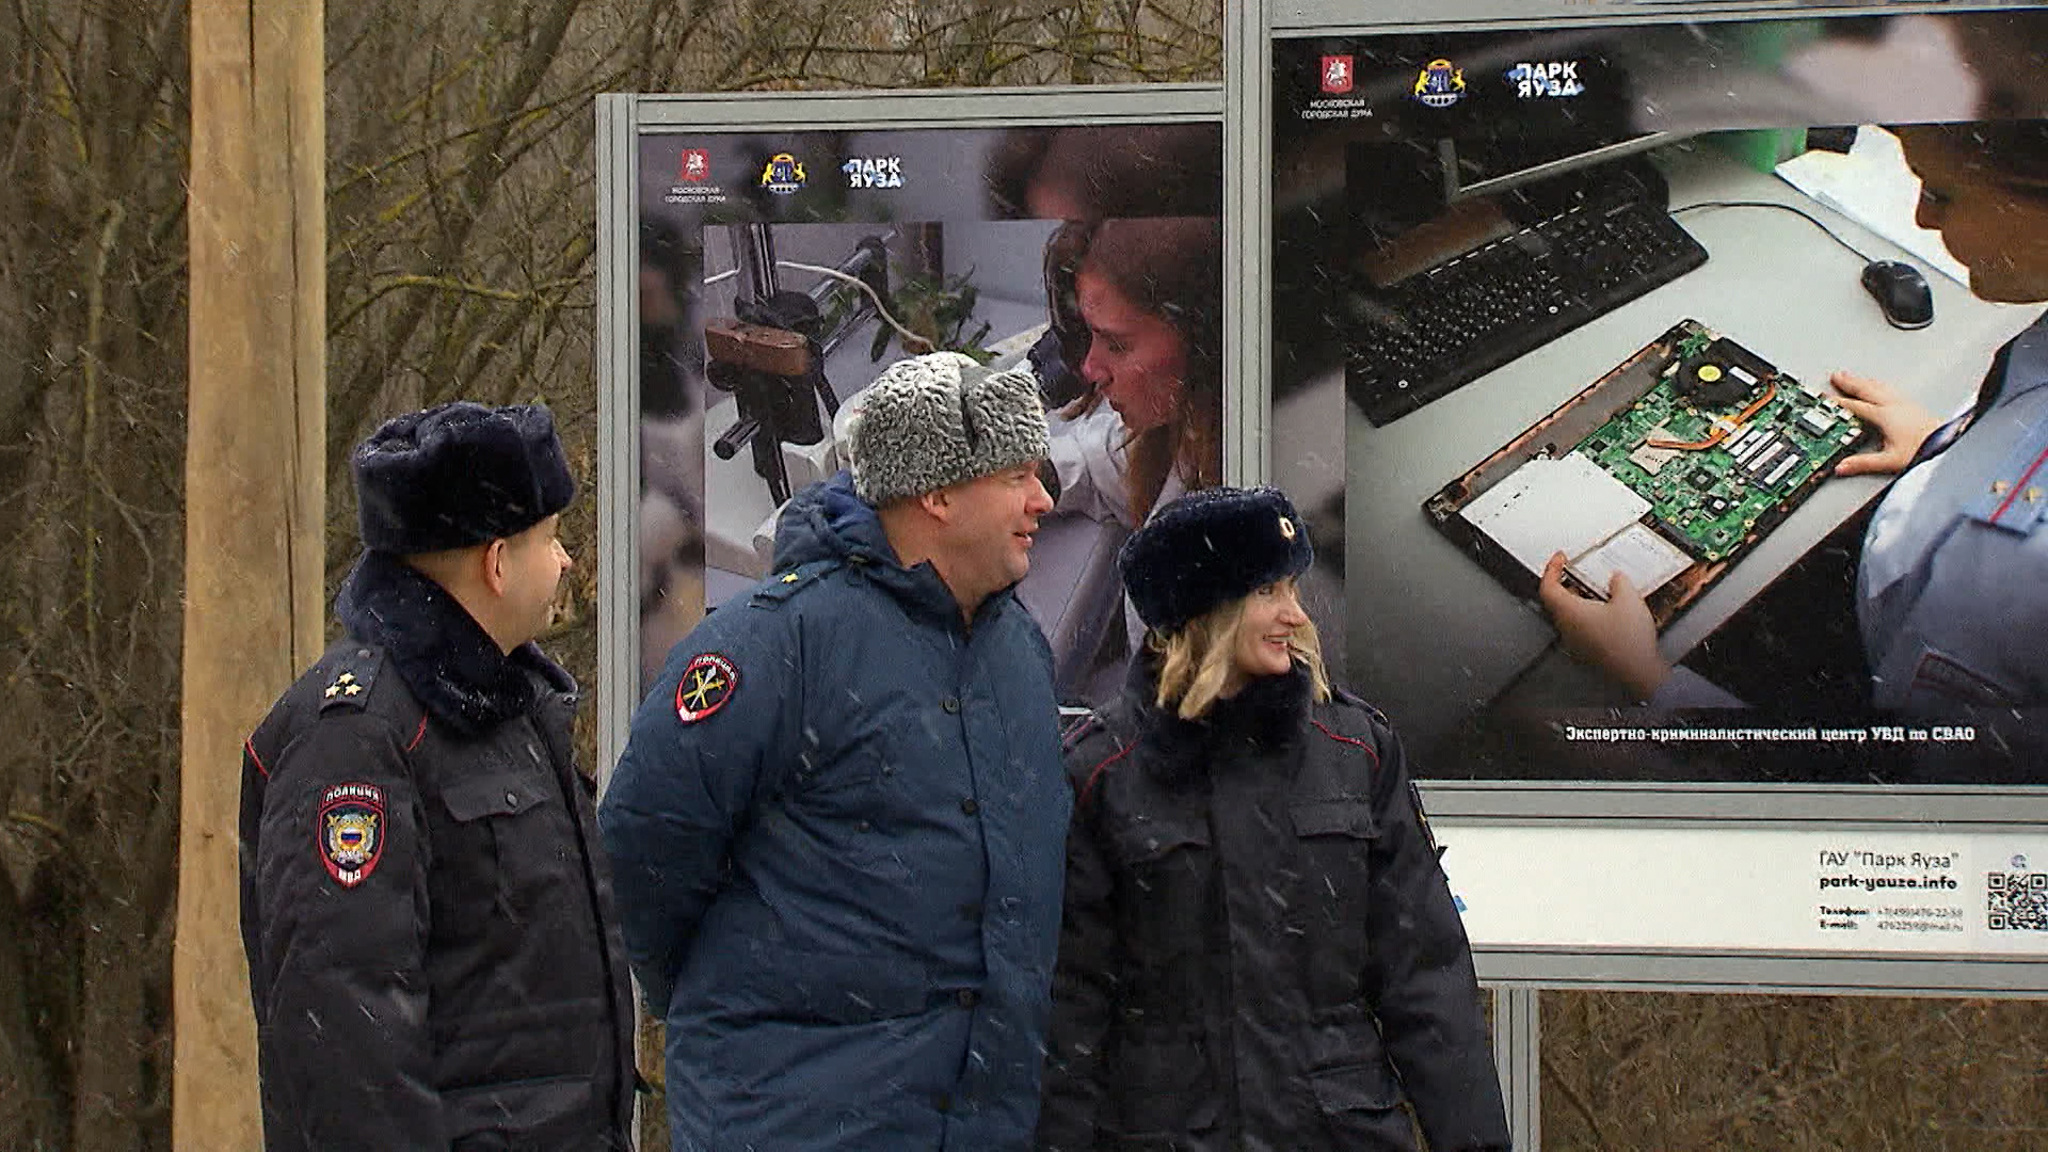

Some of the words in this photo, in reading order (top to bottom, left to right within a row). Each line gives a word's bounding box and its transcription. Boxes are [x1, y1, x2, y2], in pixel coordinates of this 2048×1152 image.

[1515, 61, 1579, 80] ПАРК
[1517, 79, 1580, 98] ЯУЗА
[848, 157, 901, 173] ПАРК
[850, 172, 902, 188] ЯУЗА
[1565, 726, 1817, 743] Экспертно-криминалистический
[1820, 728, 1867, 743] центр
[1870, 726, 1905, 742] УВД
[1908, 729, 1928, 741] по
[1931, 726, 1976, 741] СВАО
[326, 785, 379, 802] ПОЛИЦИЯ
[1819, 852, 1849, 866] ГАУ
[1853, 851, 1906, 869] "Парк
[1910, 851, 1959, 869] Яуза"
[1819, 874, 1958, 892] park-yauza.info
